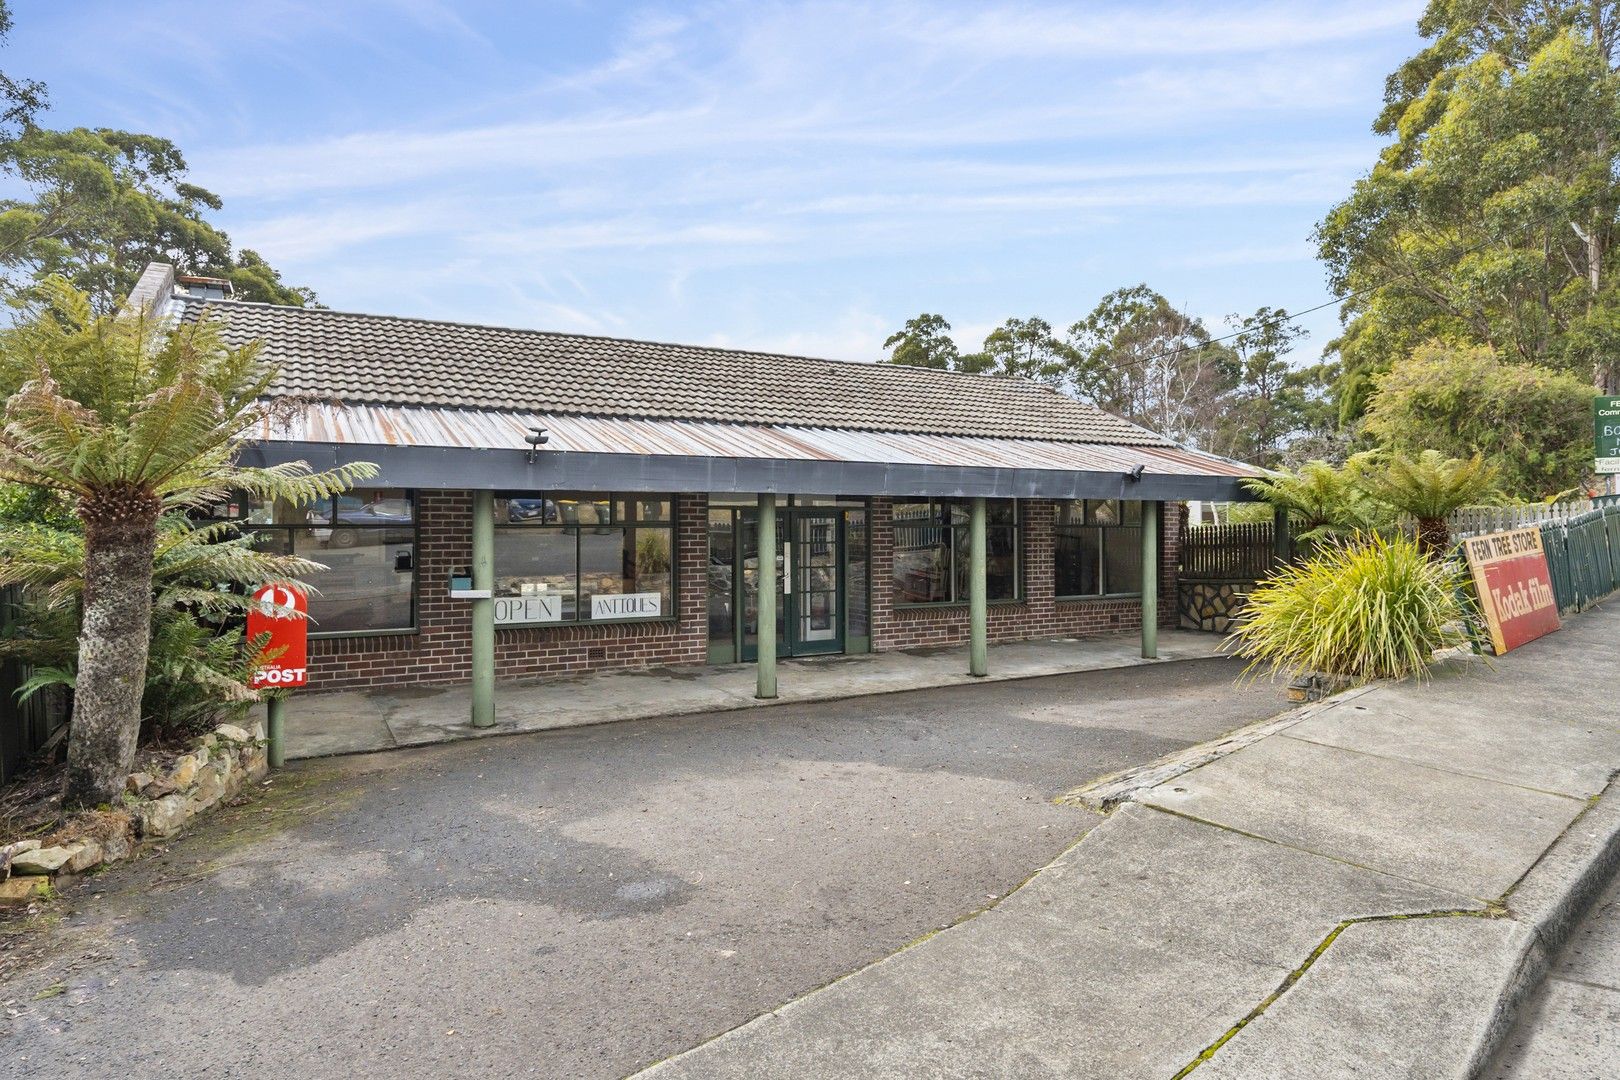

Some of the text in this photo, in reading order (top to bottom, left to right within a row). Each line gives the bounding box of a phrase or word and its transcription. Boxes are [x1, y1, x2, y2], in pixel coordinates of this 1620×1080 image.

[1471, 531, 1538, 561] FERN TREE STORE
[494, 598, 553, 621] OPEN
[595, 597, 658, 615] ANTIQUES
[1491, 577, 1554, 622] Kodak film
[253, 667, 306, 684] POST
